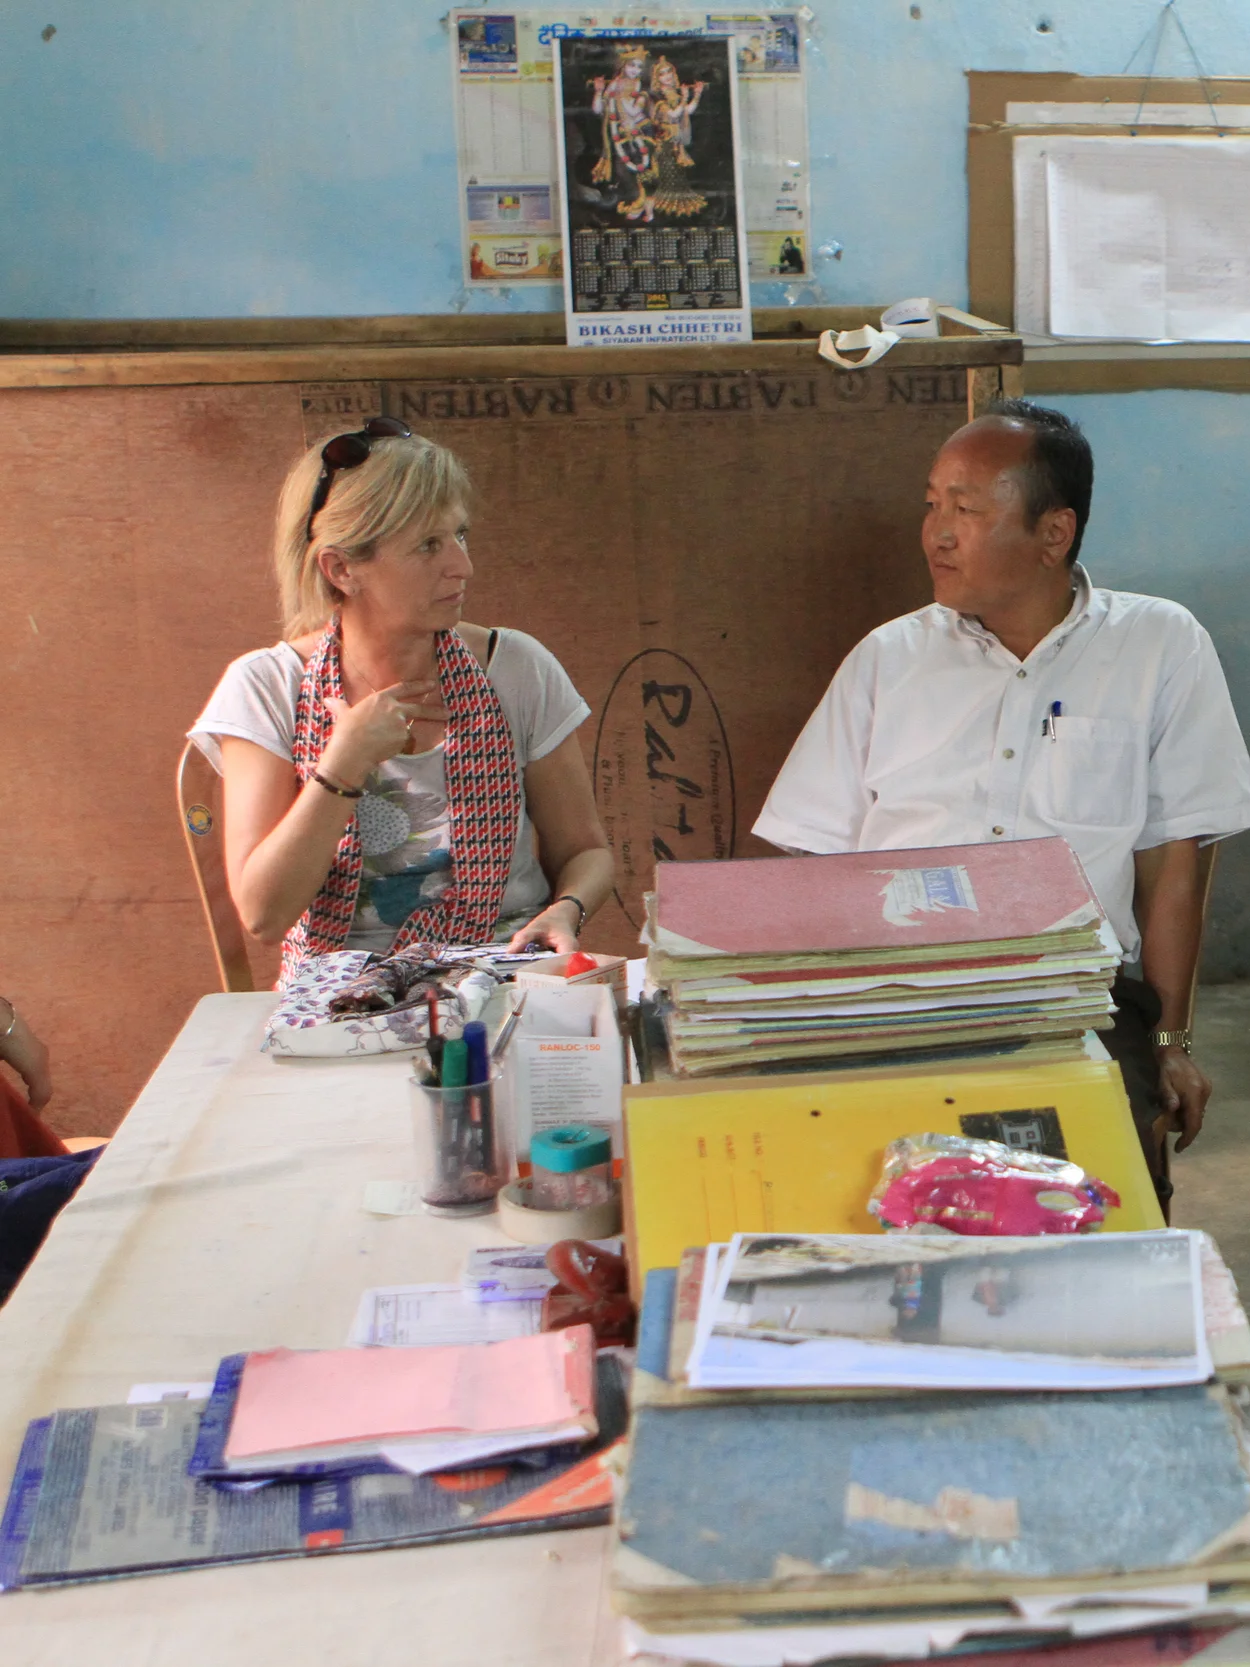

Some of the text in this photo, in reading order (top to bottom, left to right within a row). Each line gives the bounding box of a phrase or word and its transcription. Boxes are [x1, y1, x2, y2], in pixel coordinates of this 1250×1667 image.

[578, 322, 743, 337] BIKASH CHHETRI
[400, 379, 577, 418] RABTEN
[539, 1043, 601, 1052] RANLOC-150
